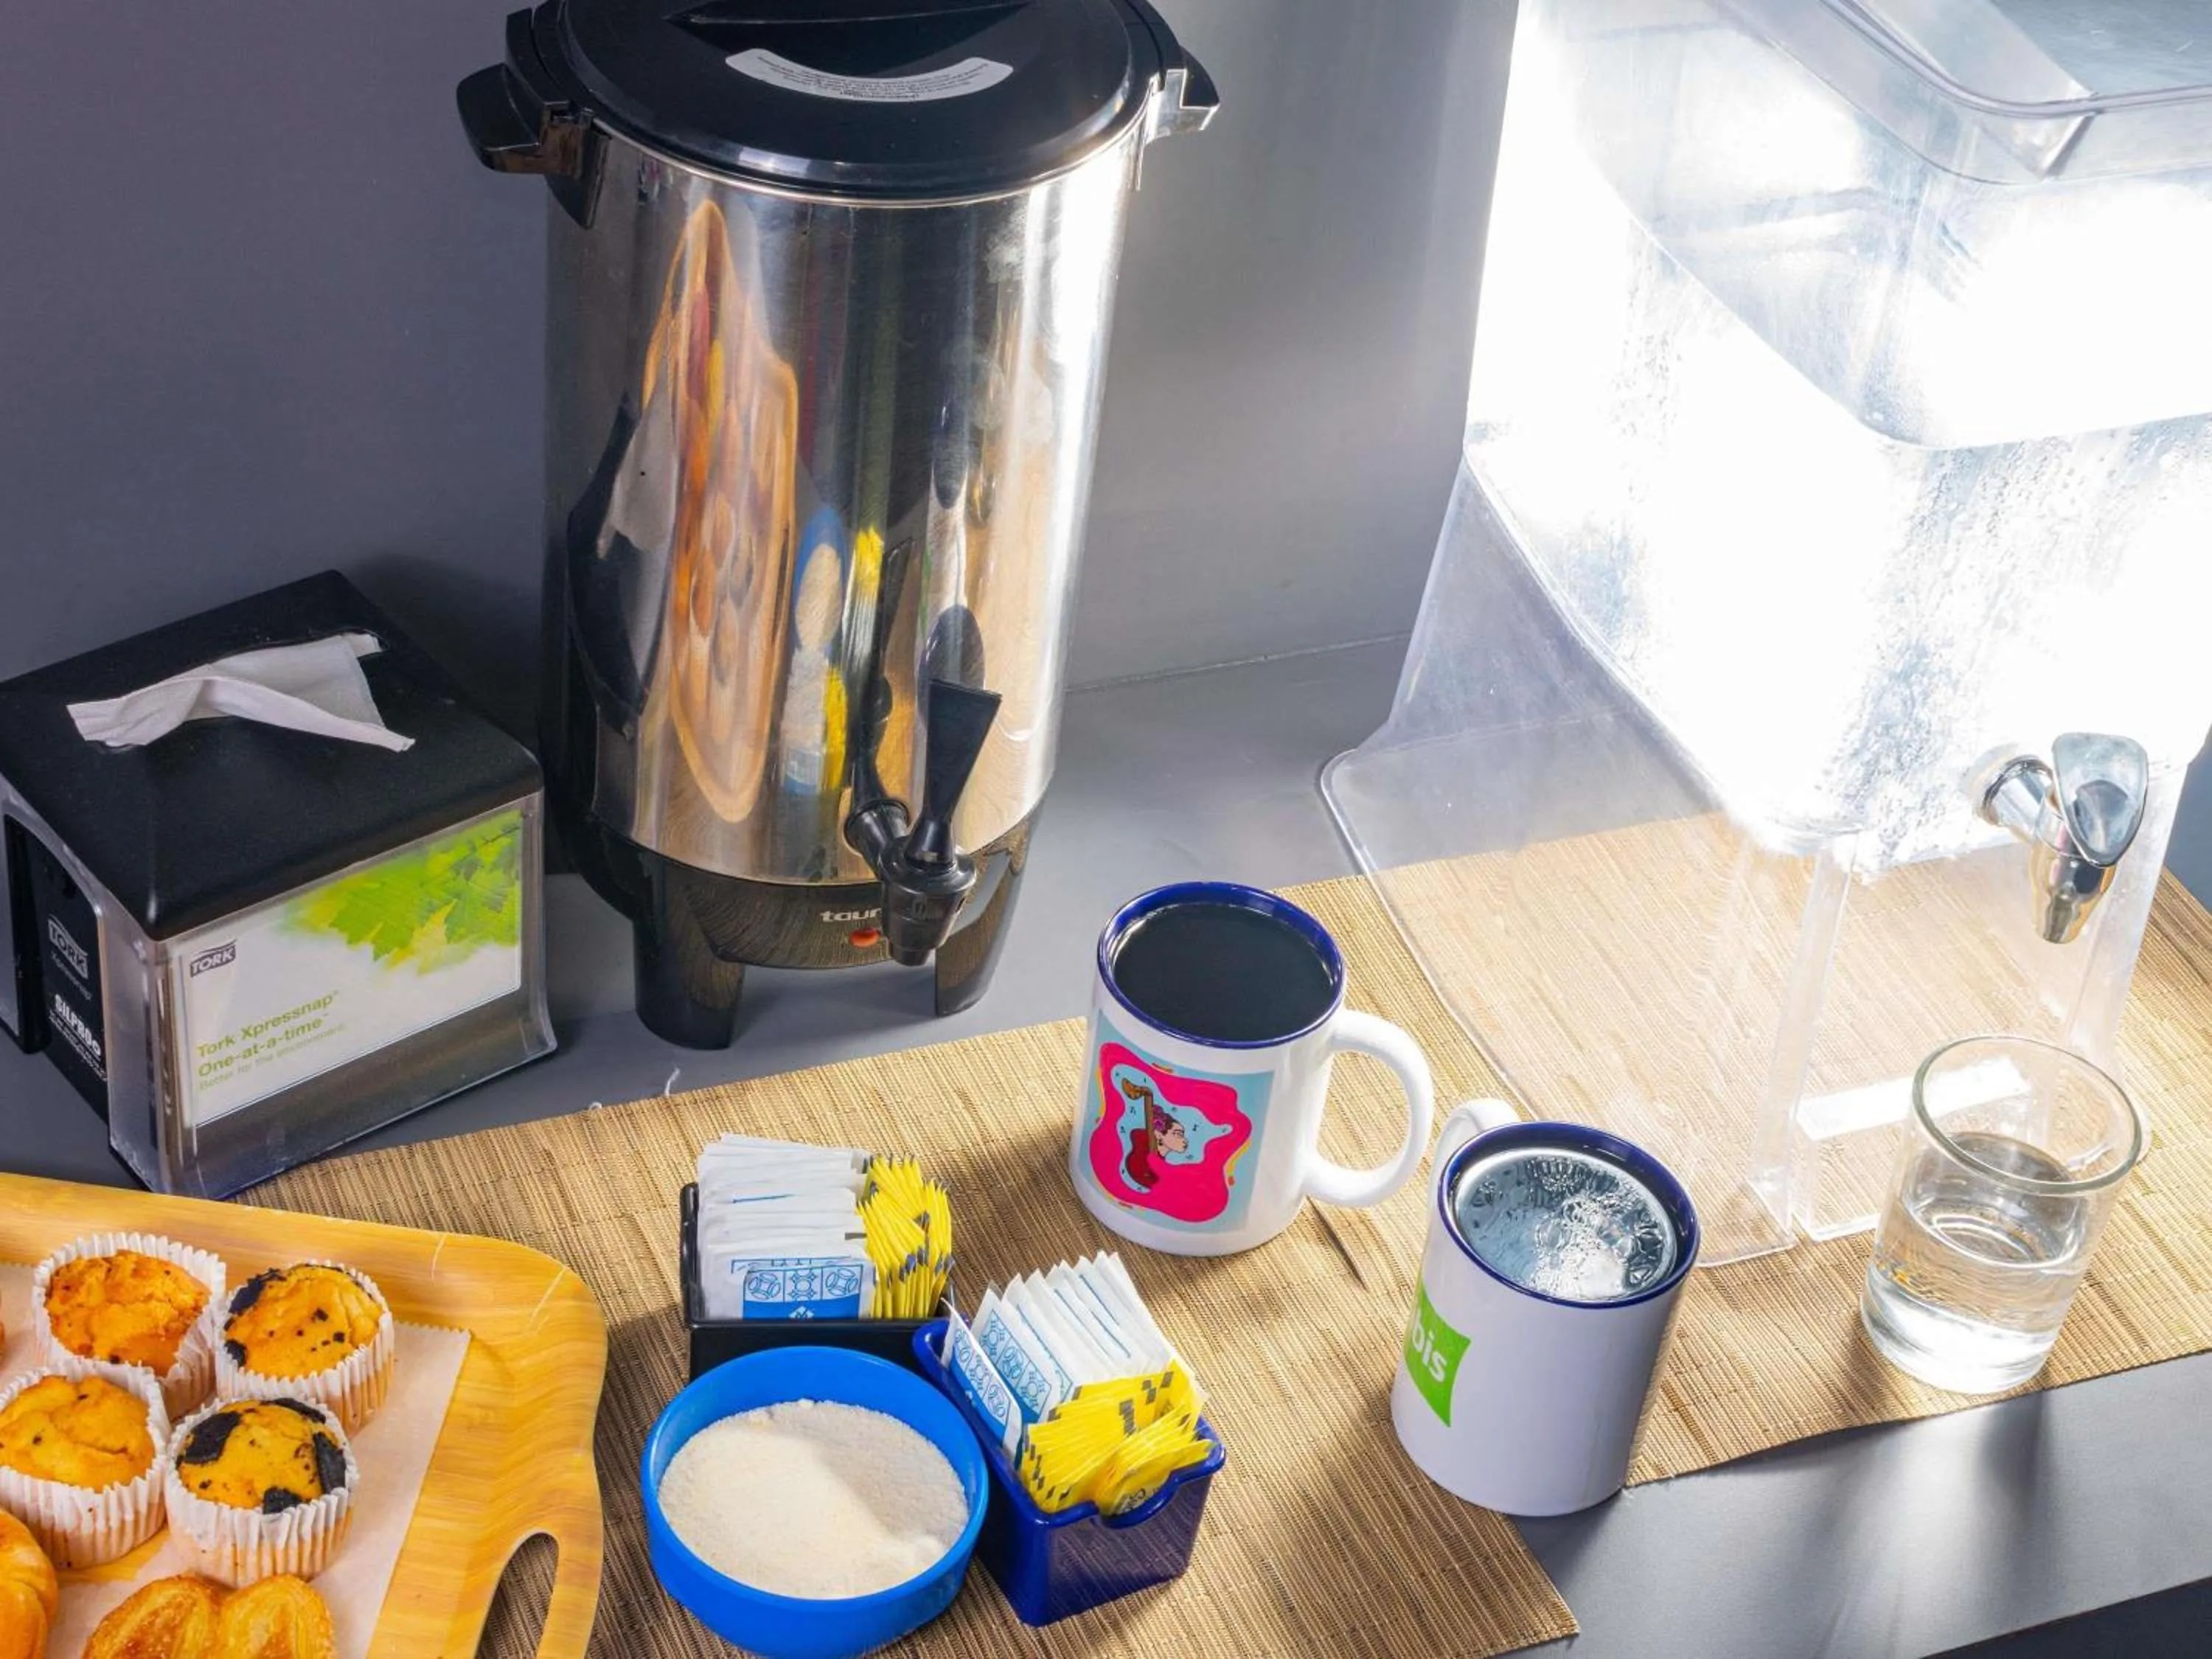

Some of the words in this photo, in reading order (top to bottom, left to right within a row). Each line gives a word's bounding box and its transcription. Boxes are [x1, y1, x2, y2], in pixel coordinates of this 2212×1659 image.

[820, 908, 883, 922] taur
[49, 922, 86, 973] TORK
[191, 945, 236, 974] TORK
[197, 1036, 236, 1057] Tork
[1412, 1307, 1448, 1383] bis
